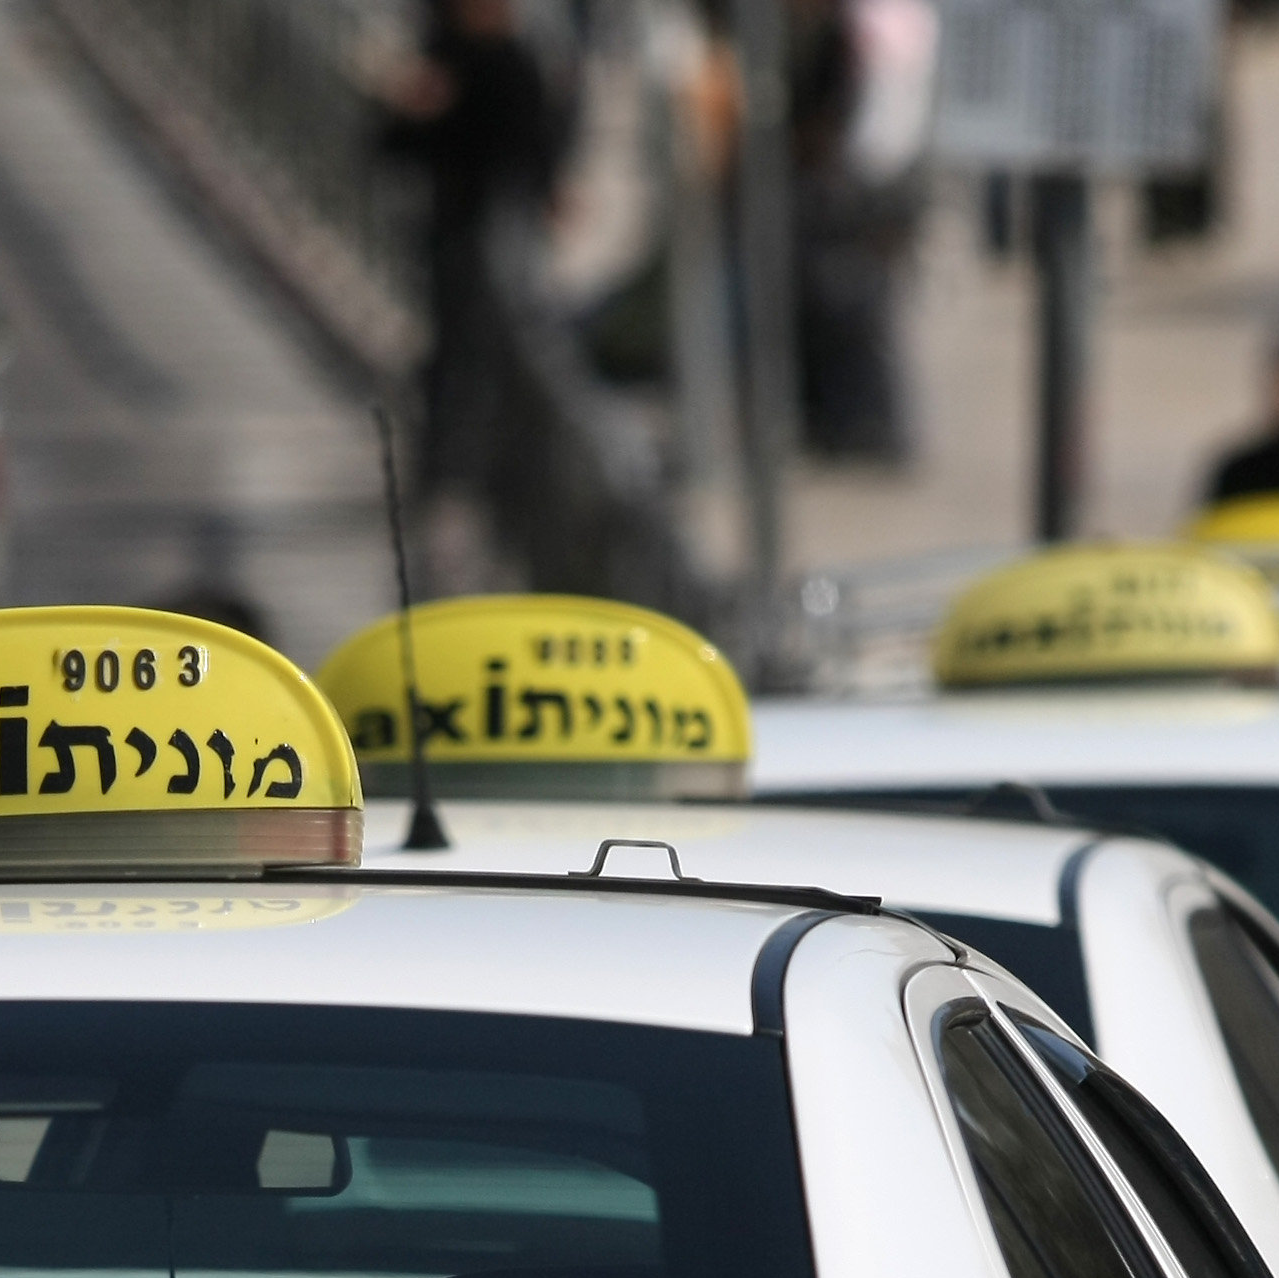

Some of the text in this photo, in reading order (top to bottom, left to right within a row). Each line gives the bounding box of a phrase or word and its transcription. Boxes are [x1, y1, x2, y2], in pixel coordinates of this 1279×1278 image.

[60, 645, 204, 692] 9063
[354, 657, 713, 752] axi מונית
[38, 718, 303, 800] מונית
